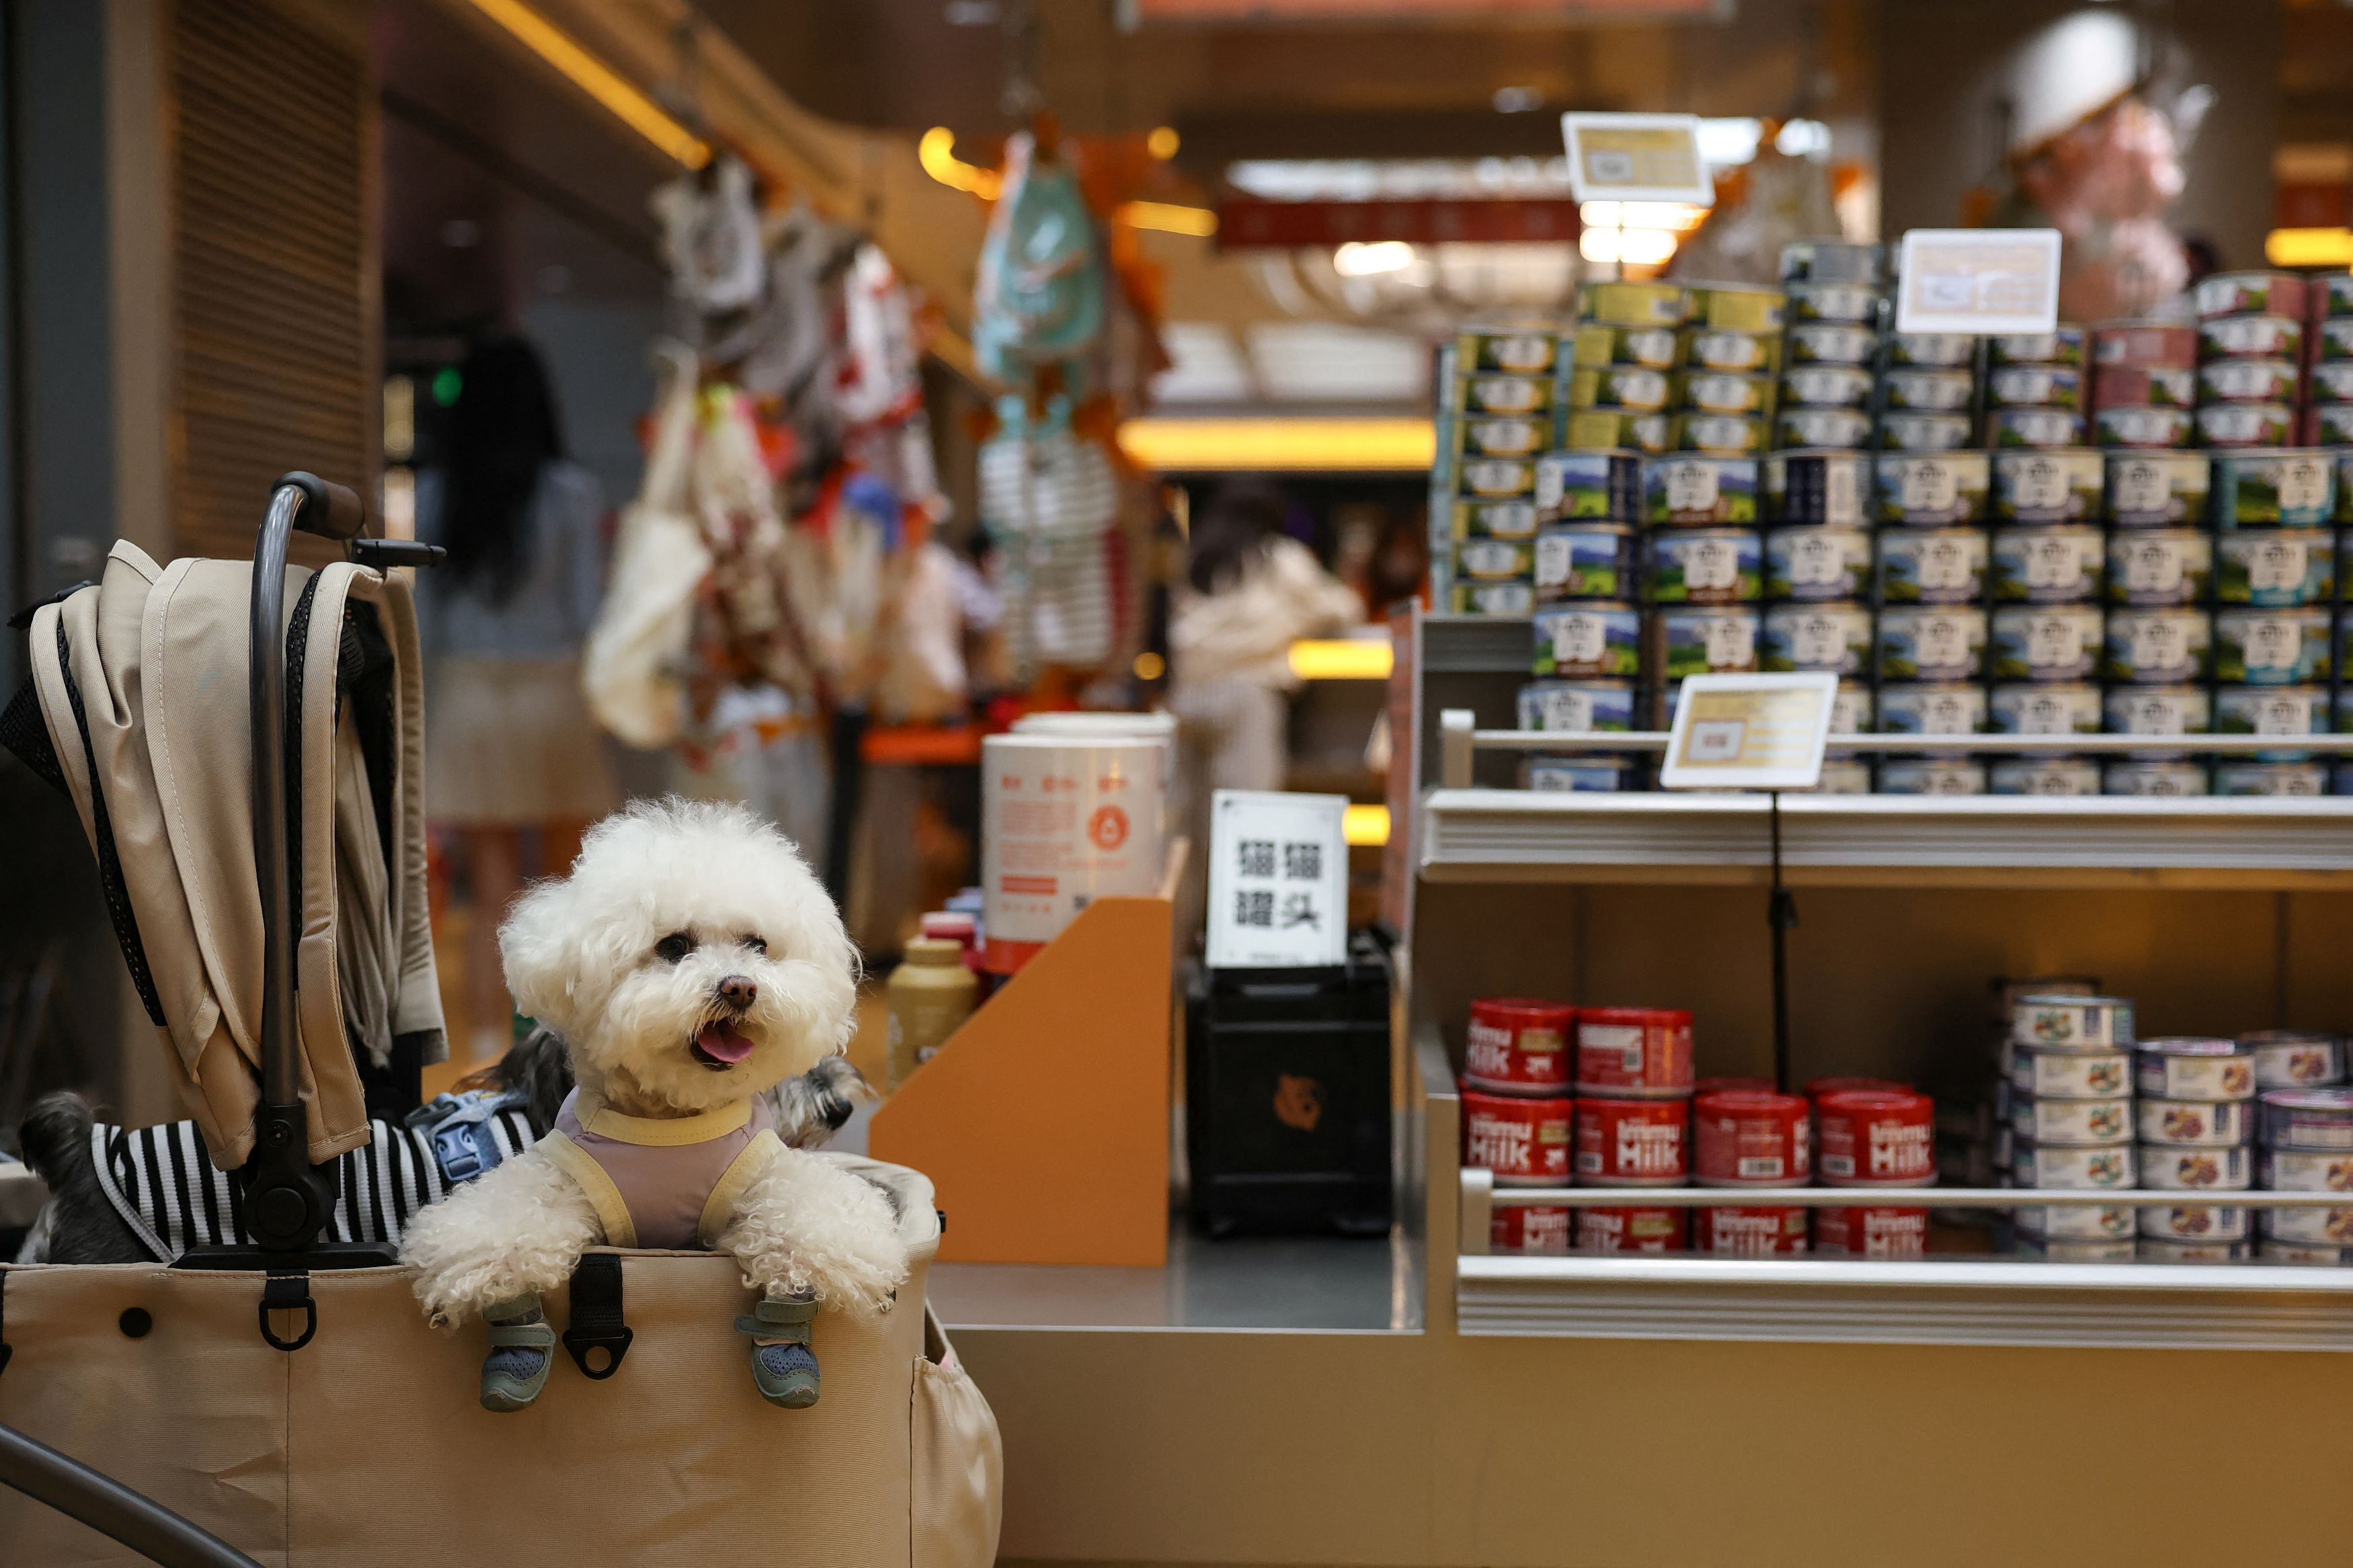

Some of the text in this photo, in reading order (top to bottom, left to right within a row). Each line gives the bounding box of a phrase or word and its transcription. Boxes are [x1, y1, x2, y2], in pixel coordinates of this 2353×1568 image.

[1236, 890, 1322, 932] 罐头
[1468, 1139, 1531, 1169] Milk
[1617, 1141, 1679, 1170] Milk
[1870, 1143, 1931, 1173] Milk
